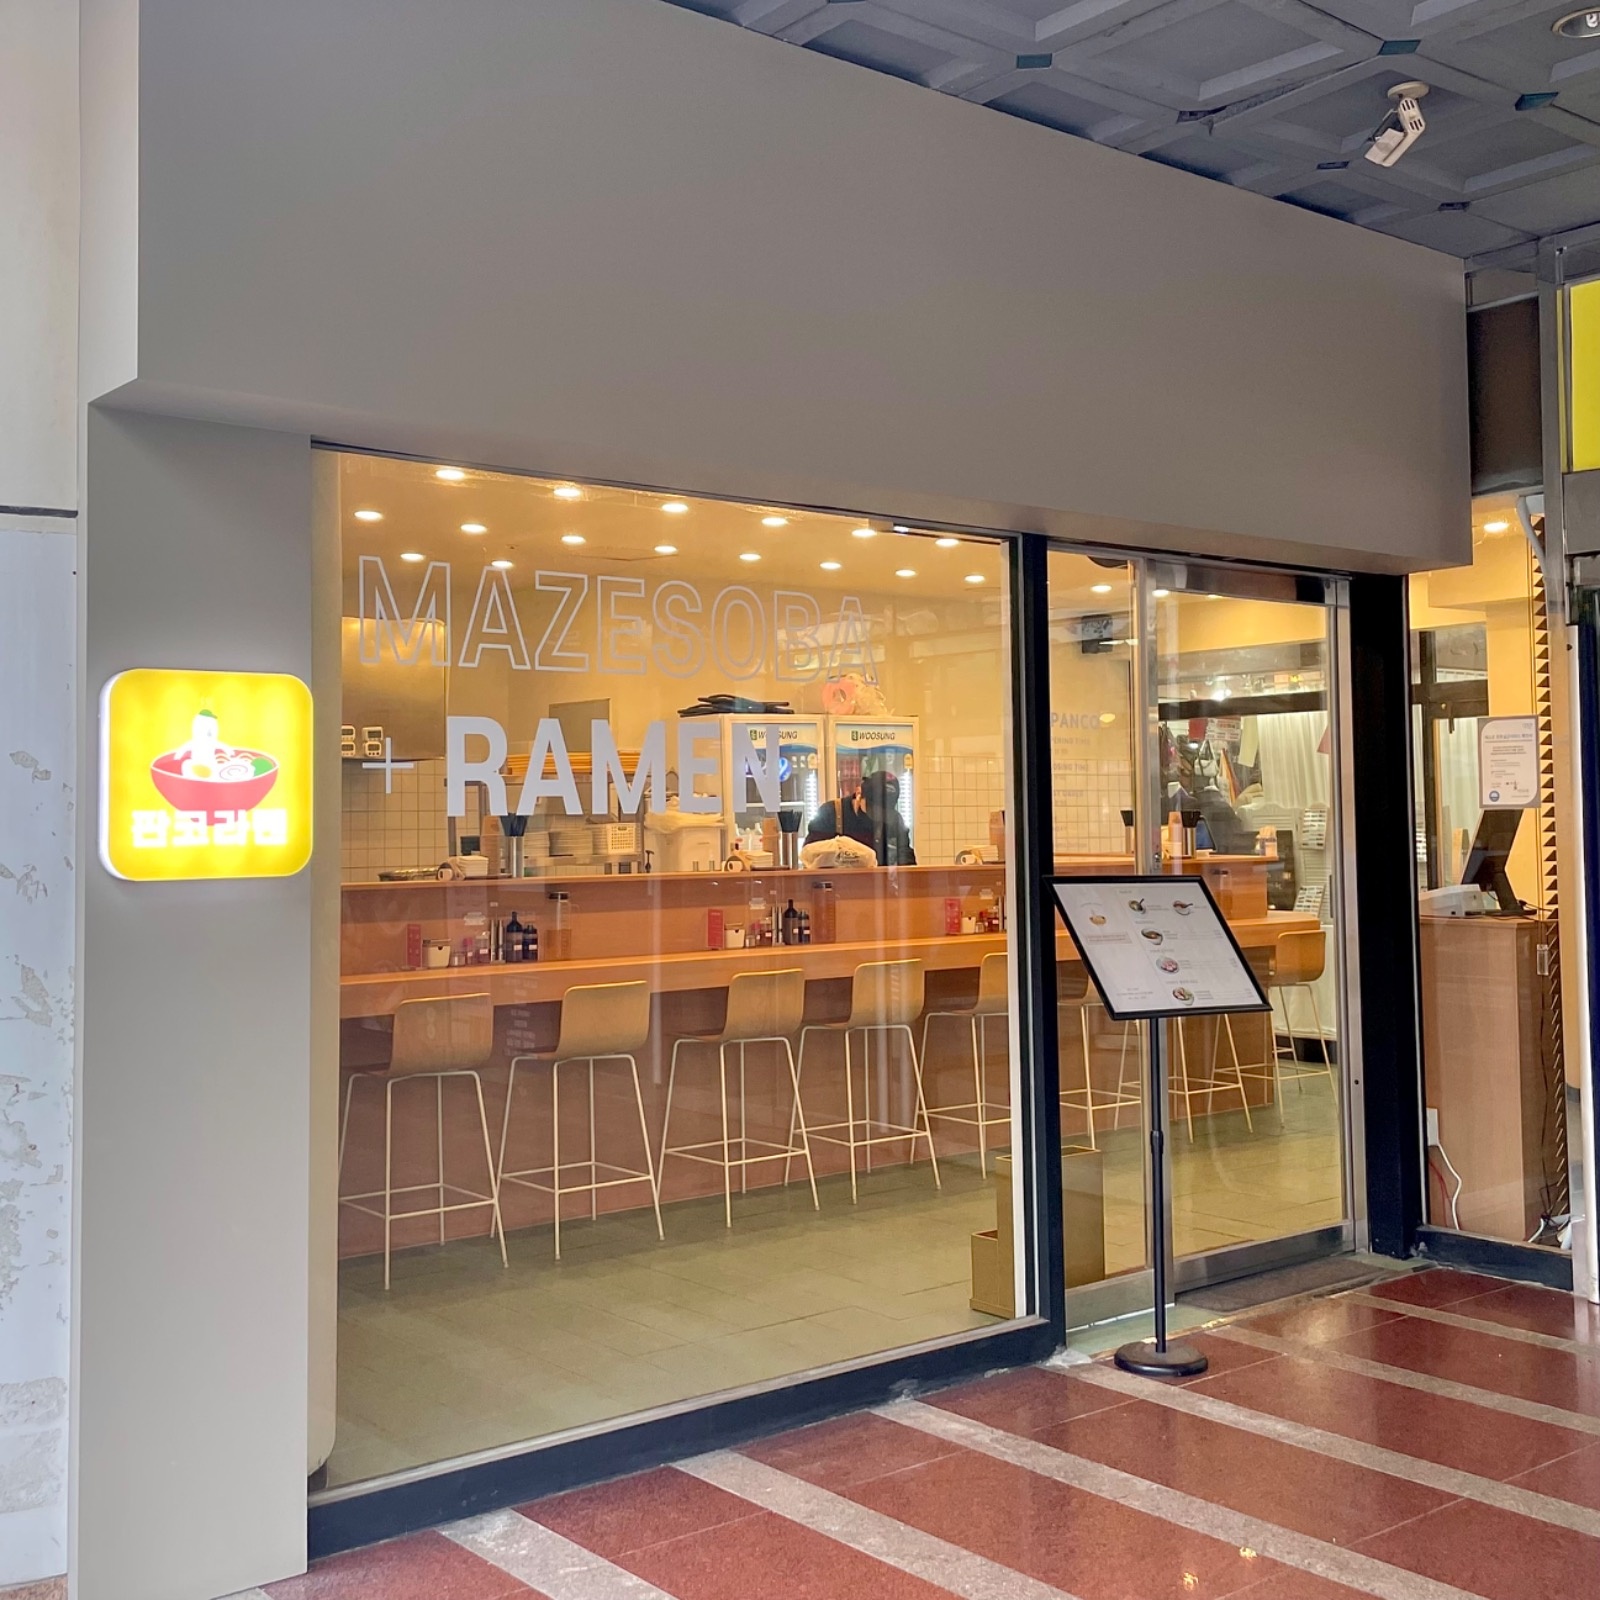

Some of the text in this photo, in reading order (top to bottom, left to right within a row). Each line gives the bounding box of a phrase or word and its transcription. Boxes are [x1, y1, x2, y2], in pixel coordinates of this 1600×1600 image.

[358, 555, 880, 686] MAZESOBA
[1050, 711, 1101, 730] PANCO
[758, 730, 798, 740] WSUNG
[859, 731, 896, 741] WOOSUNG
[446, 715, 781, 818] RAMEN
